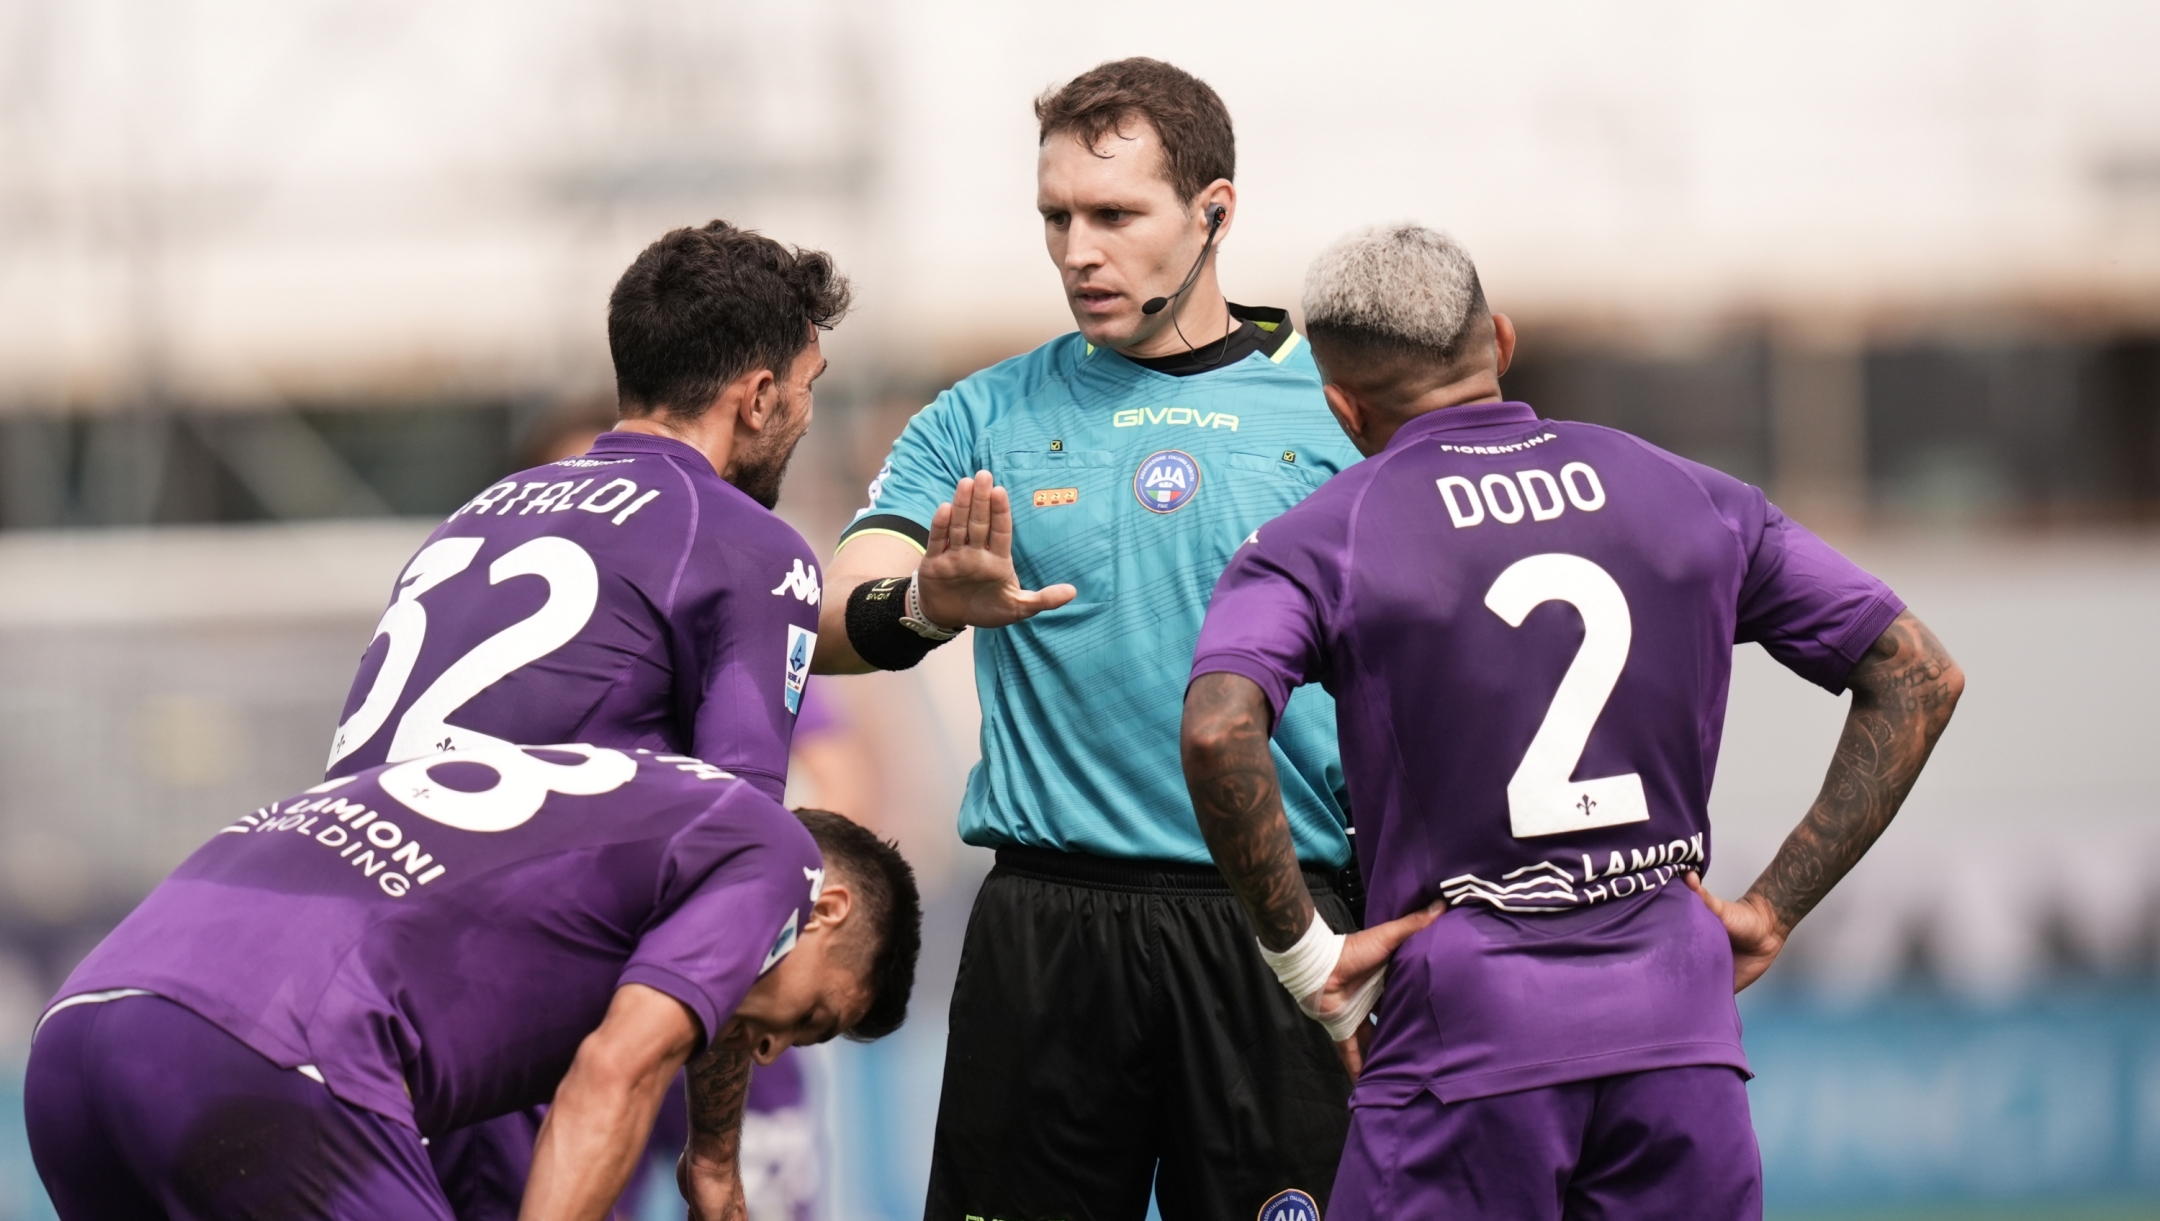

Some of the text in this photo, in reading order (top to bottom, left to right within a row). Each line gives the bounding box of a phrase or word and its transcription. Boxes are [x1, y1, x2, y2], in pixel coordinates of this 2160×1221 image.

[1113, 407, 1239, 432] GIVOVA
[1440, 432, 1558, 455] FIORENTINA
[447, 477, 661, 526] ATALDI
[1145, 466, 1186, 488] AIA
[1435, 462, 1607, 529] DODO
[325, 536, 599, 773] 32
[1484, 552, 1651, 839] 2
[256, 814, 411, 898] HOLDING
[283, 797, 447, 886] LAMIONI
